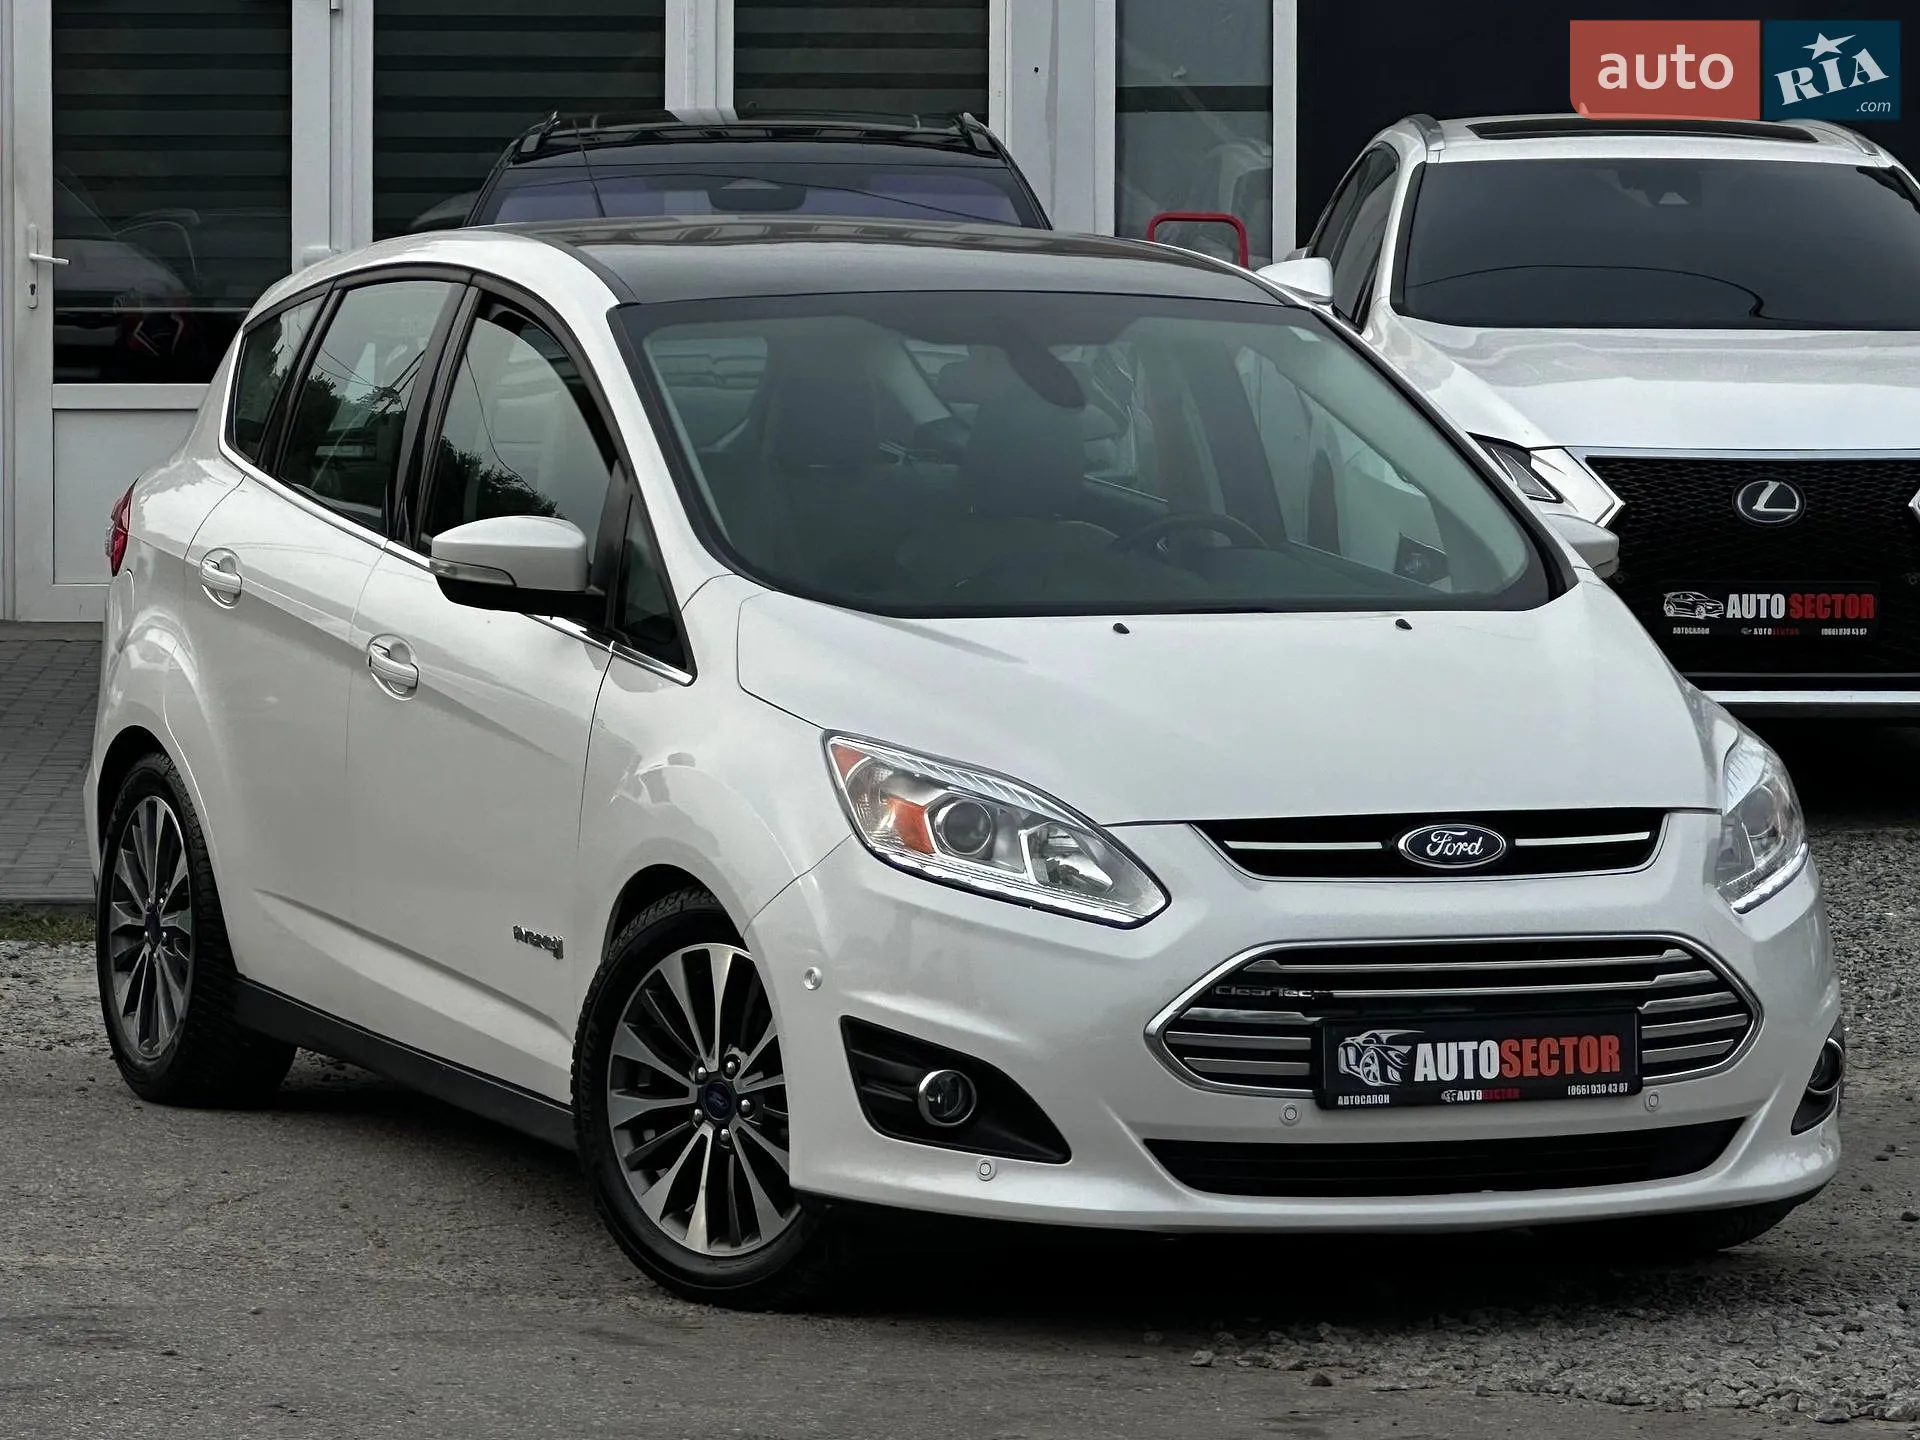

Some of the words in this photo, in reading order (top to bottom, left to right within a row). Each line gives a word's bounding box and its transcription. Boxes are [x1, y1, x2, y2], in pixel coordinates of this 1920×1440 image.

[1726, 593, 1786, 619] AUTO
[1788, 593, 1875, 619] SECTOR
[1426, 830, 1484, 857] Ford
[1414, 1034, 1621, 1083] AUTOSECTOR
